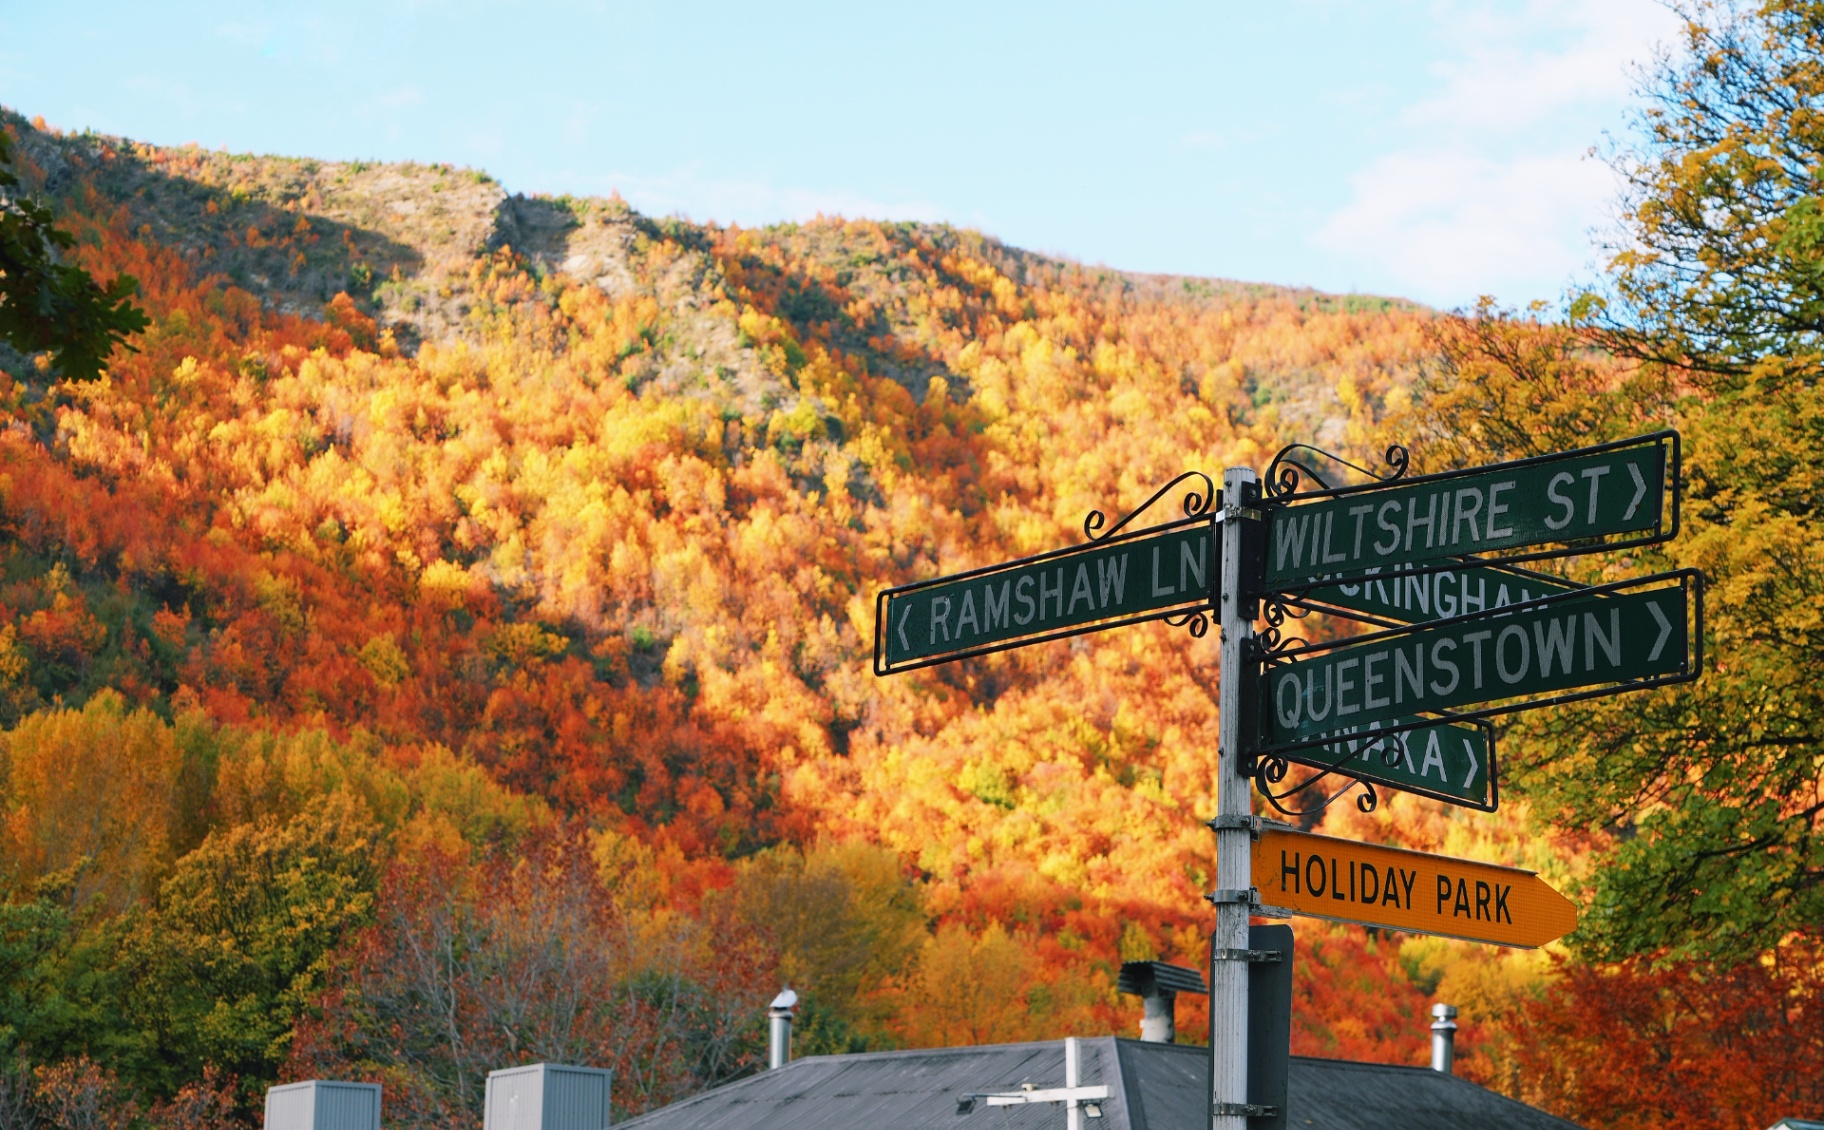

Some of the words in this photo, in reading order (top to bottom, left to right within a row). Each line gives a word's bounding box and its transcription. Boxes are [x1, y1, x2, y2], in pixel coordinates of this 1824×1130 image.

[1275, 480, 1516, 572] WILTSHIRE
[1543, 465, 1611, 531] ST
[929, 552, 1129, 646] RAMSHAW
[1151, 536, 1207, 598] LN
[1308, 562, 1549, 623] KINGHA
[1276, 607, 1622, 730] QUEENSTOWN
[1291, 718, 1447, 783] AKA
[1280, 850, 1417, 910] HOLIDAY
[1437, 874, 1513, 925] PARK
